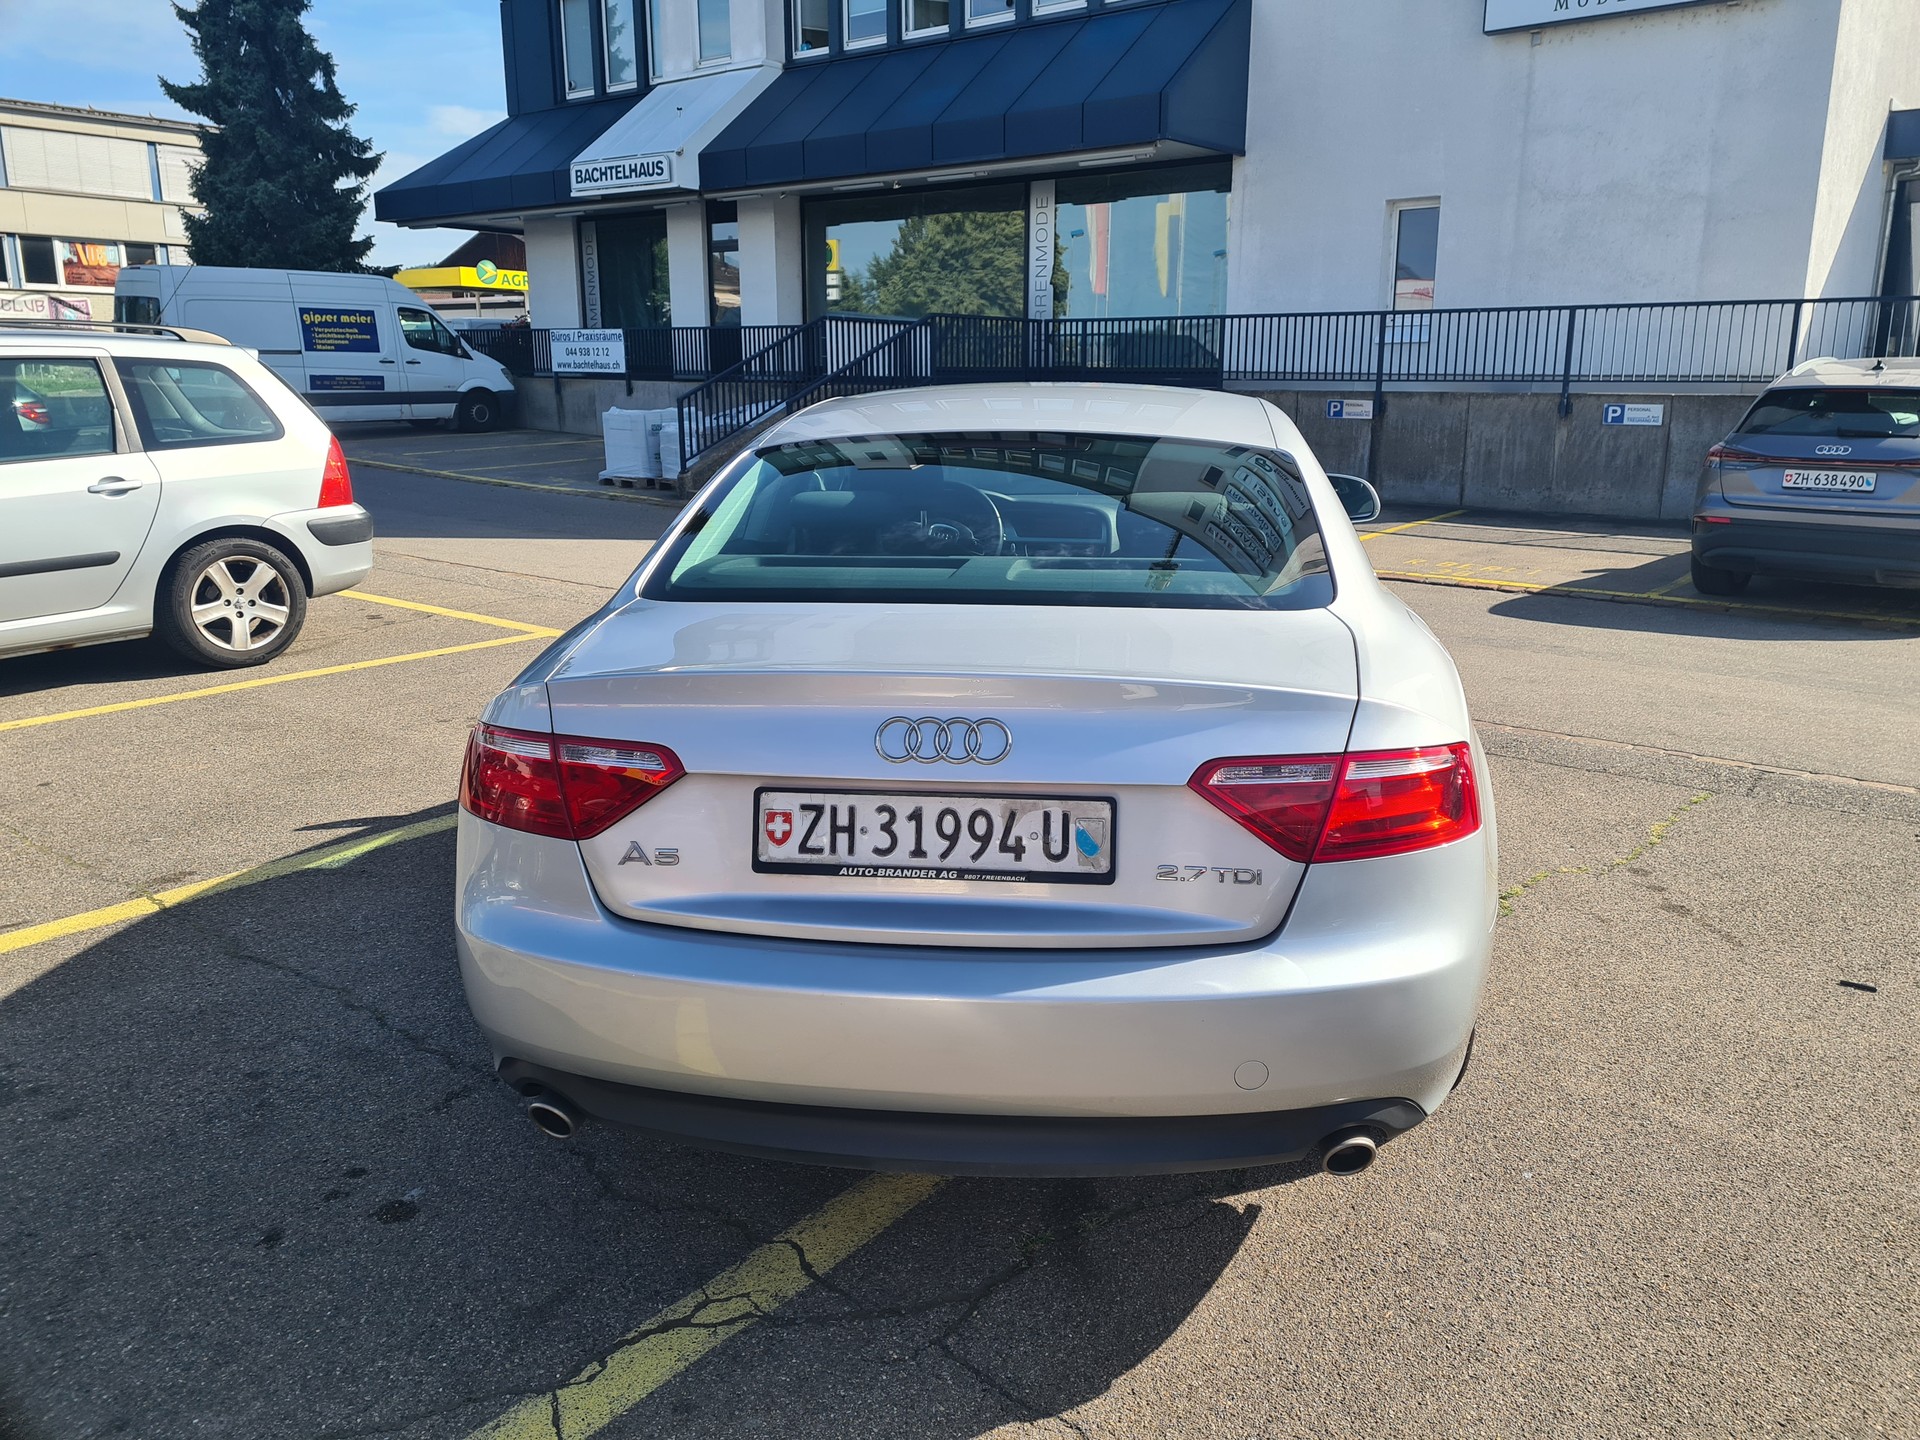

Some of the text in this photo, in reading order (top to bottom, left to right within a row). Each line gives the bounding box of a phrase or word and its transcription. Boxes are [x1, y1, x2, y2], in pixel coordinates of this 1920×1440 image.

[575, 160, 664, 184] BACHTELHAUS
[1035, 196, 1049, 319] RRENMODE
[585, 233, 598, 329] AMENMODE
[303, 311, 338, 324] gipser
[340, 313, 371, 323] meier
[551, 331, 571, 341] Büros
[577, 330, 623, 341] Praxisräume
[565, 347, 610, 356] 044 938 12 12
[556, 360, 621, 370] www.bachtelhaus.ch
[1330, 402, 1341, 417] P
[1607, 406, 1622, 423] P
[618, 841, 680, 866] A5
[838, 867, 936, 879] AUTO-BRANDER
[940, 870, 957, 879] AG
[982, 874, 1026, 882] FREIENBACH
[1156, 865, 1262, 885] 2.7 TDI
